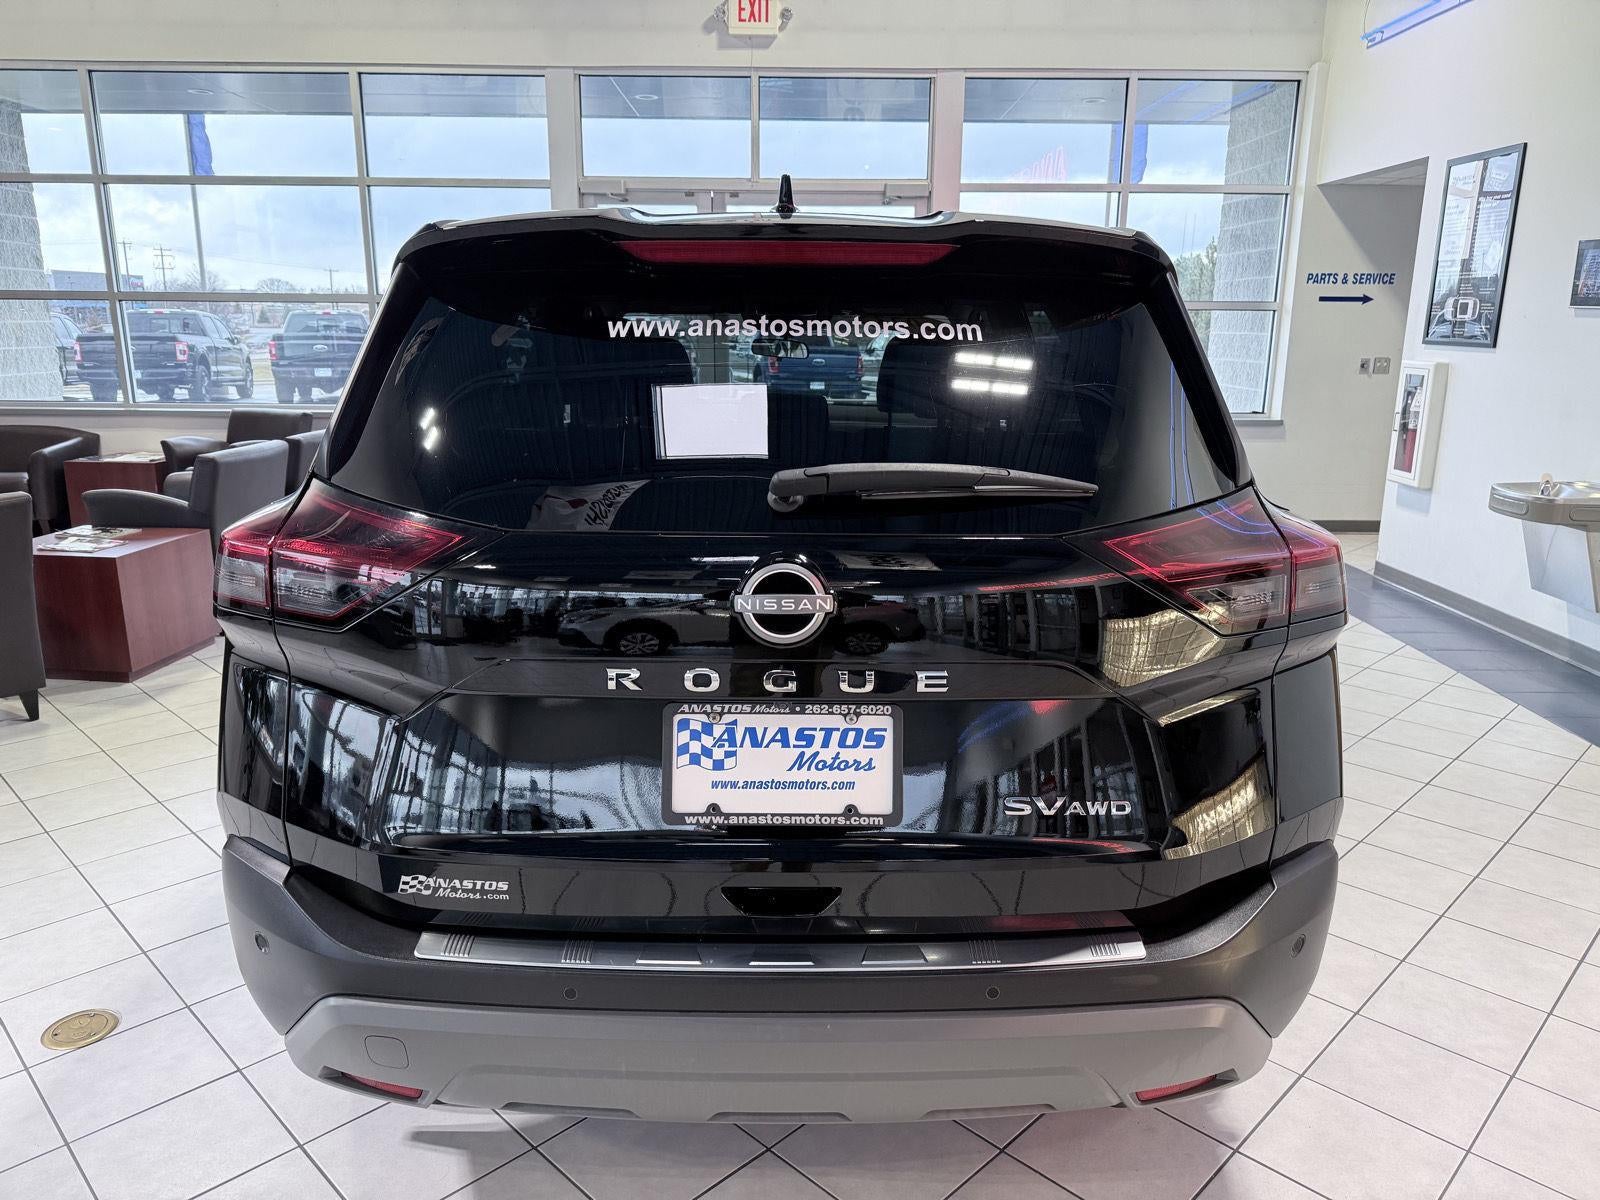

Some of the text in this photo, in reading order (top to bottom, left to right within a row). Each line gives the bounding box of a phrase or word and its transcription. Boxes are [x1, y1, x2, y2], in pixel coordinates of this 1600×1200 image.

[738, 0, 769, 22] EXIT
[1306, 273, 1396, 285] PARTS & SERVICE
[607, 315, 984, 342] www.anastosmotors.com
[737, 598, 831, 611] NISSAN
[606, 668, 950, 693] ROGUE
[677, 704, 892, 715] ANASTOS Motors 262-657-6020
[711, 726, 888, 749] ANASTOS
[786, 750, 876, 772] Motors
[711, 779, 856, 790] www.anastosmotors.com
[684, 815, 884, 826] www.anastosmotors.com
[422, 877, 510, 891] ANASTOS
